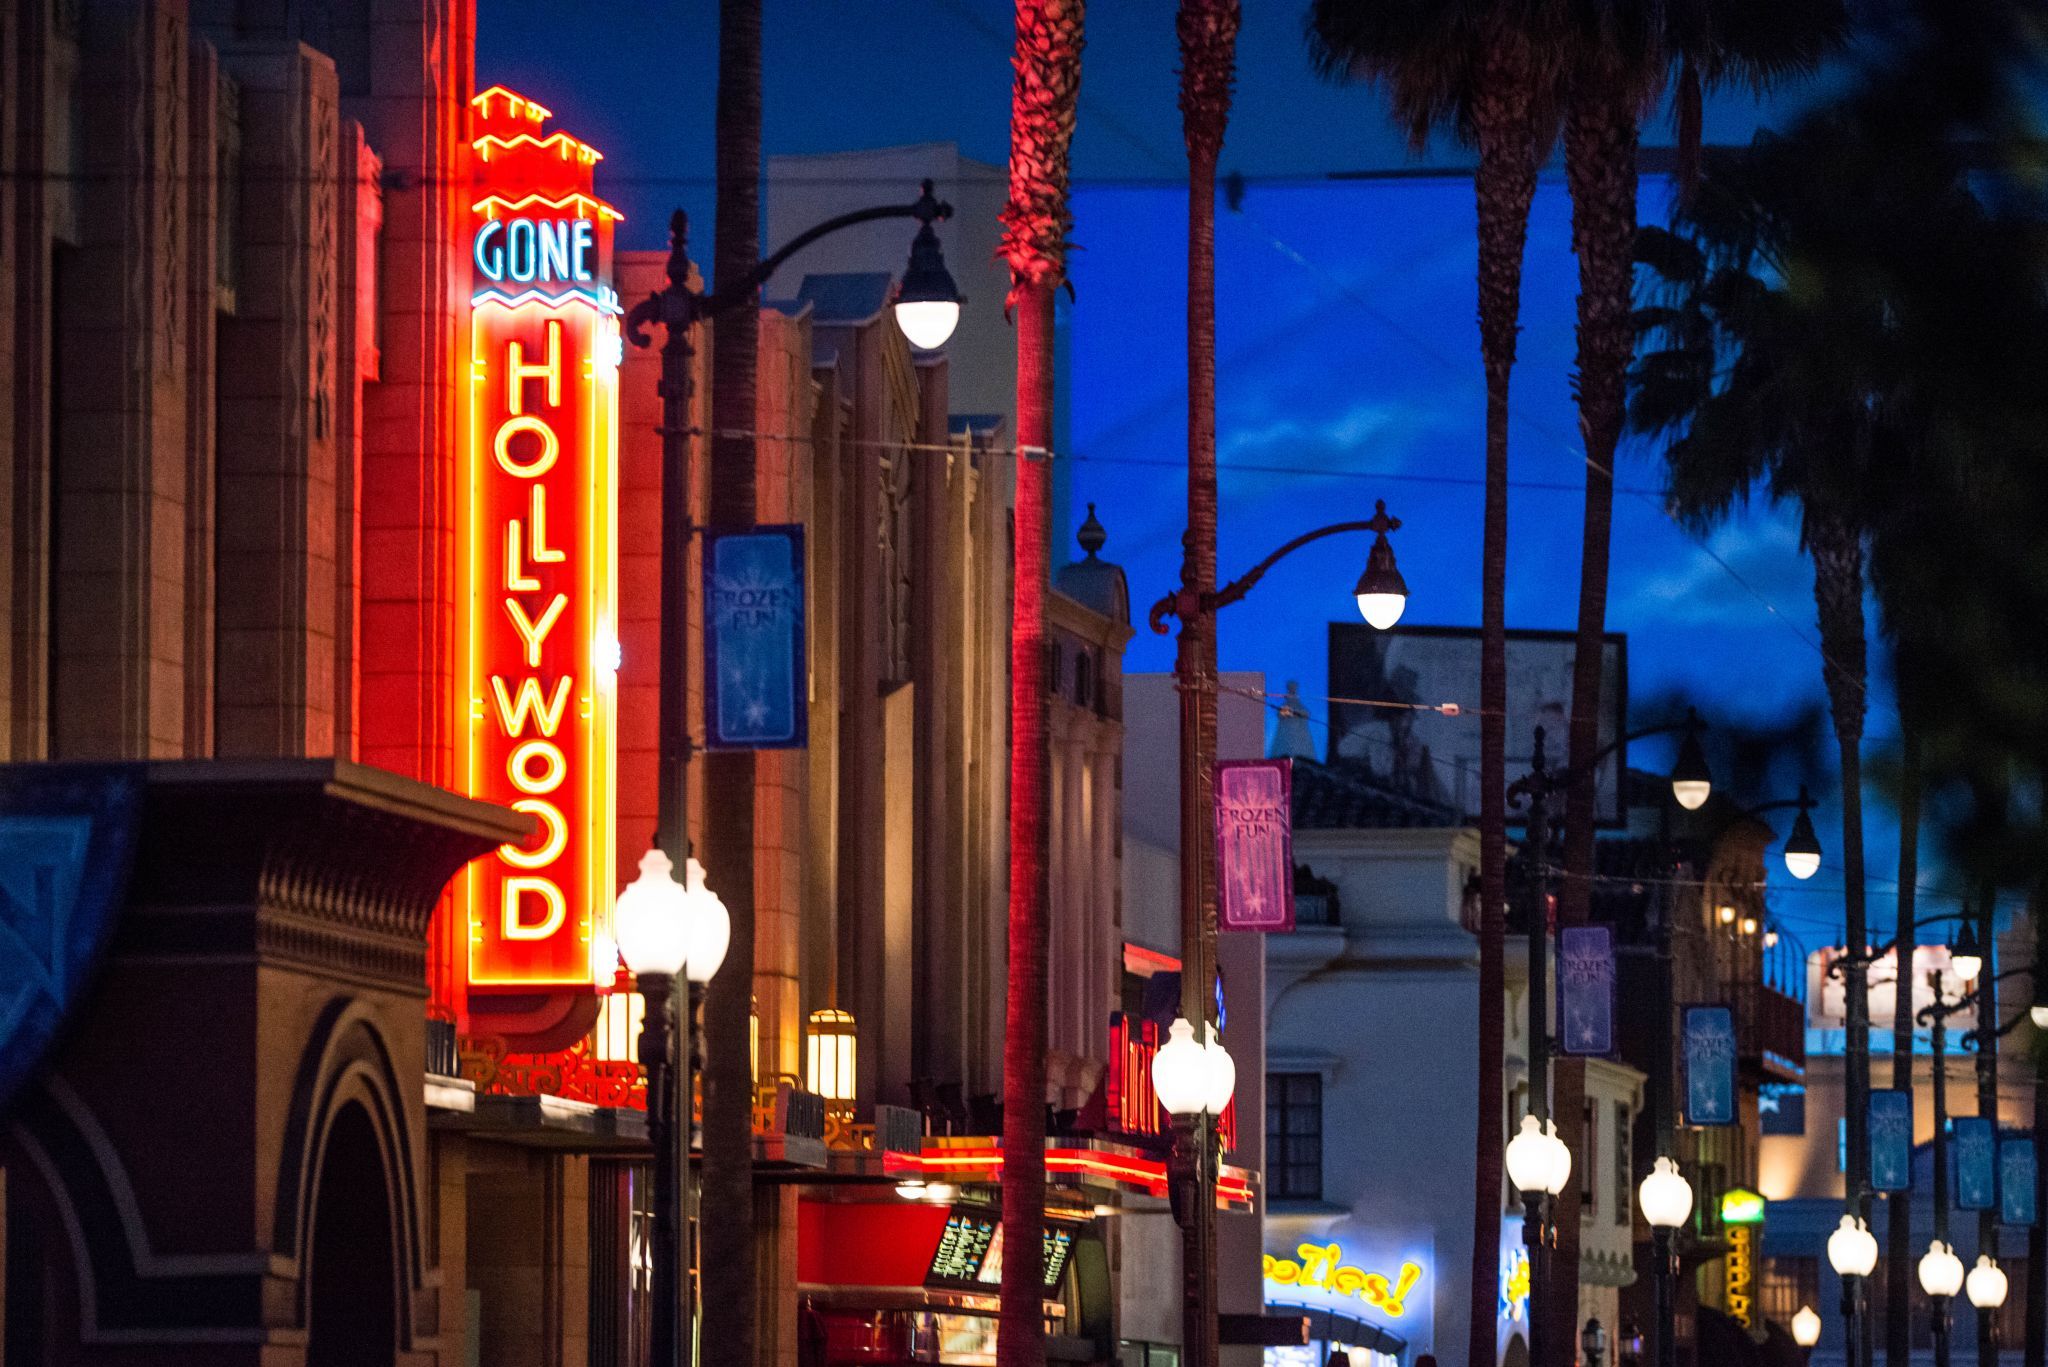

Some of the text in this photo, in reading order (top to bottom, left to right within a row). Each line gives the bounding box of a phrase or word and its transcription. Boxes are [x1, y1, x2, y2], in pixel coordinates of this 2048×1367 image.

[474, 218, 593, 282] GONE
[490, 319, 572, 941] HOLLYWOOD
[731, 608, 777, 630] FUN
[1217, 806, 1289, 829] FROZEN
[1236, 824, 1270, 840] FUN
